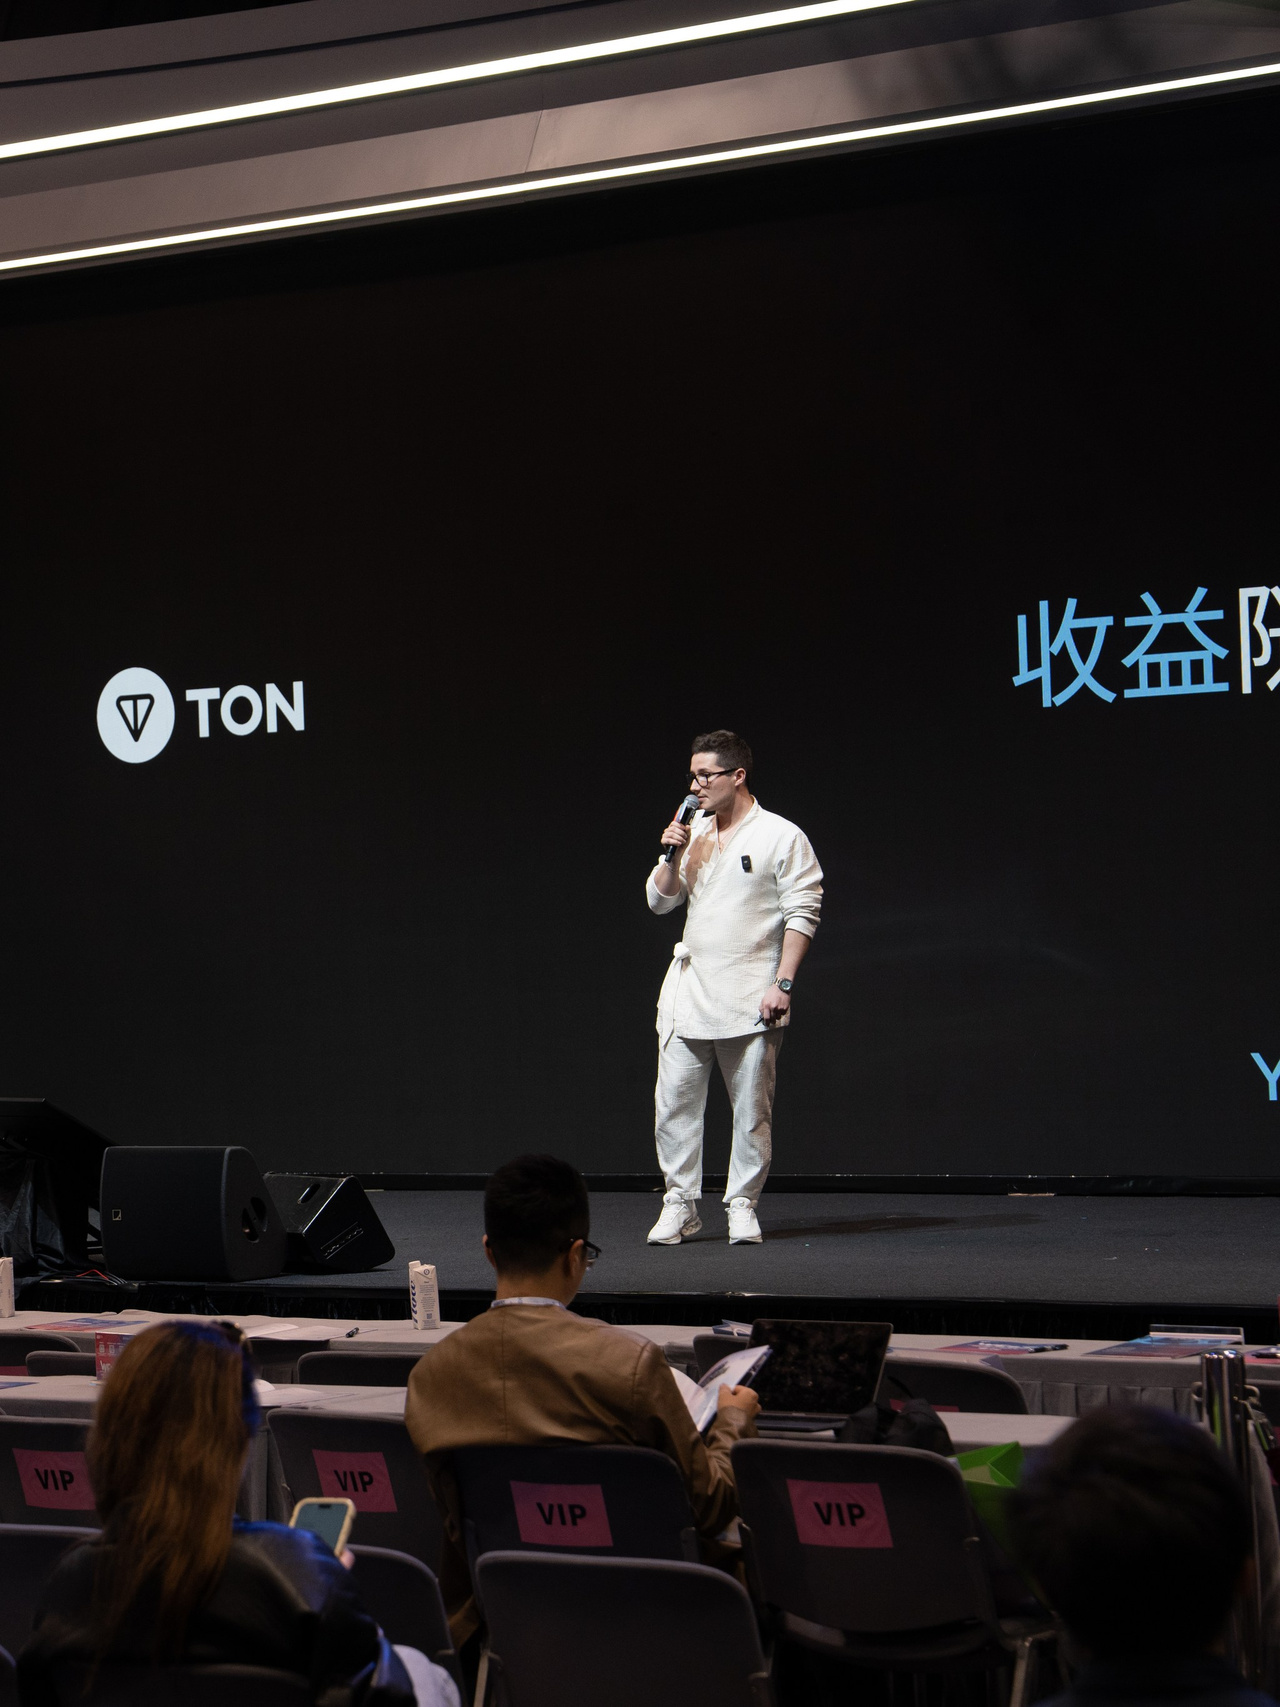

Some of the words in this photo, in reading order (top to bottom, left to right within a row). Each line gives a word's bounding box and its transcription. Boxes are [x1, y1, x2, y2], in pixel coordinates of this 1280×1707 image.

[185, 681, 305, 738] TON
[34, 1467, 74, 1491] VIP
[333, 1469, 373, 1492] VIP
[536, 1501, 586, 1526] VIP
[813, 1501, 865, 1526] VIP
